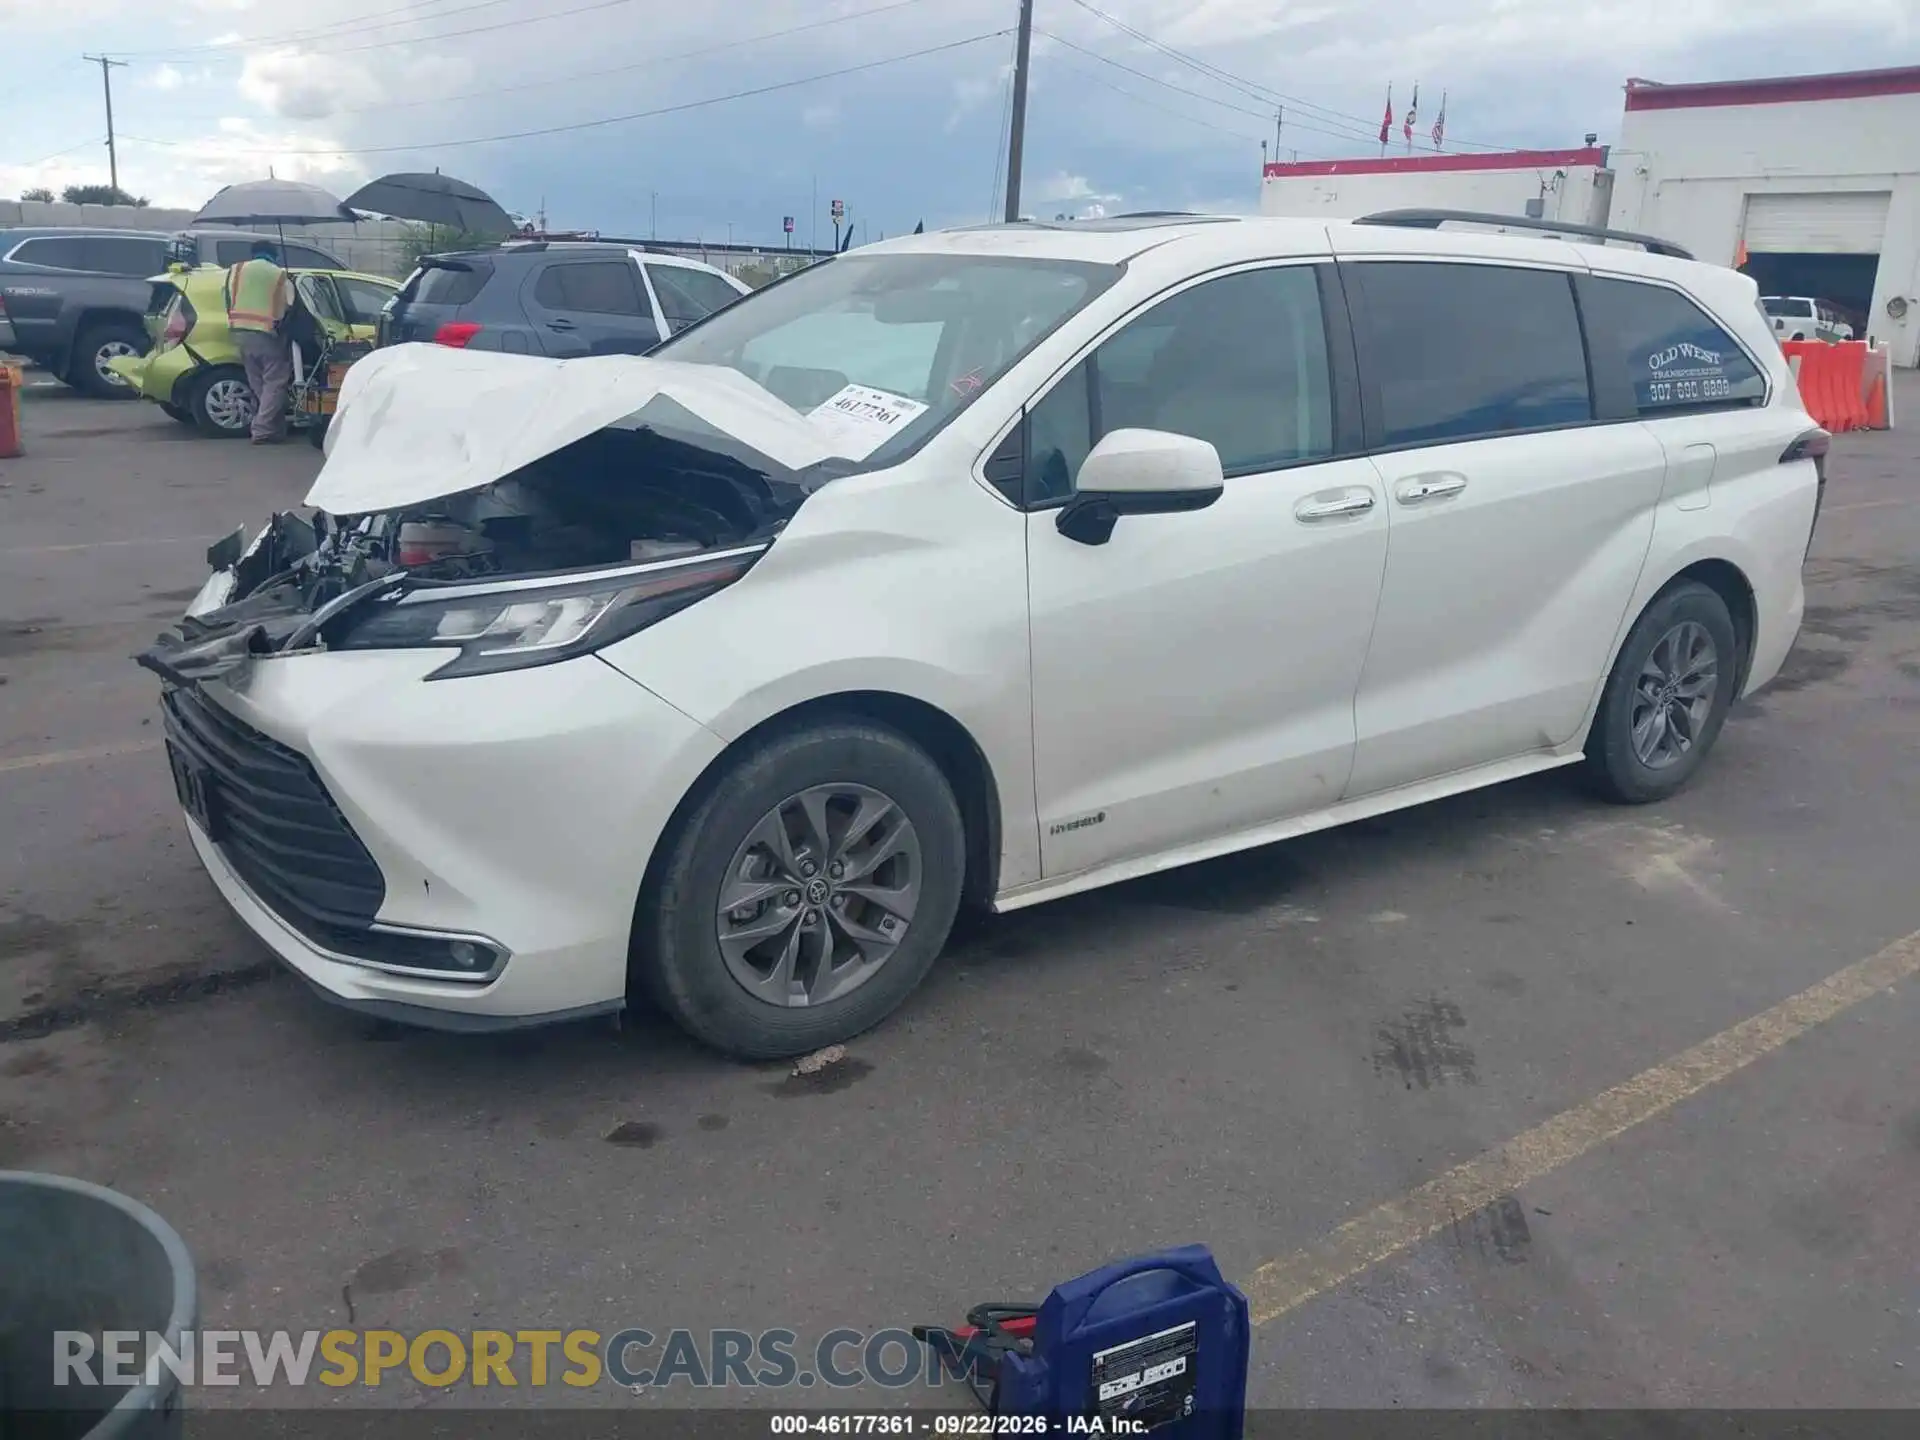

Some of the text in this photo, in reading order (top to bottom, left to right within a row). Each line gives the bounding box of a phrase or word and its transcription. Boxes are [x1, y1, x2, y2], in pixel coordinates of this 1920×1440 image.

[1648, 343, 1721, 370] OLD WEST
[834, 398, 902, 425] 46177361
